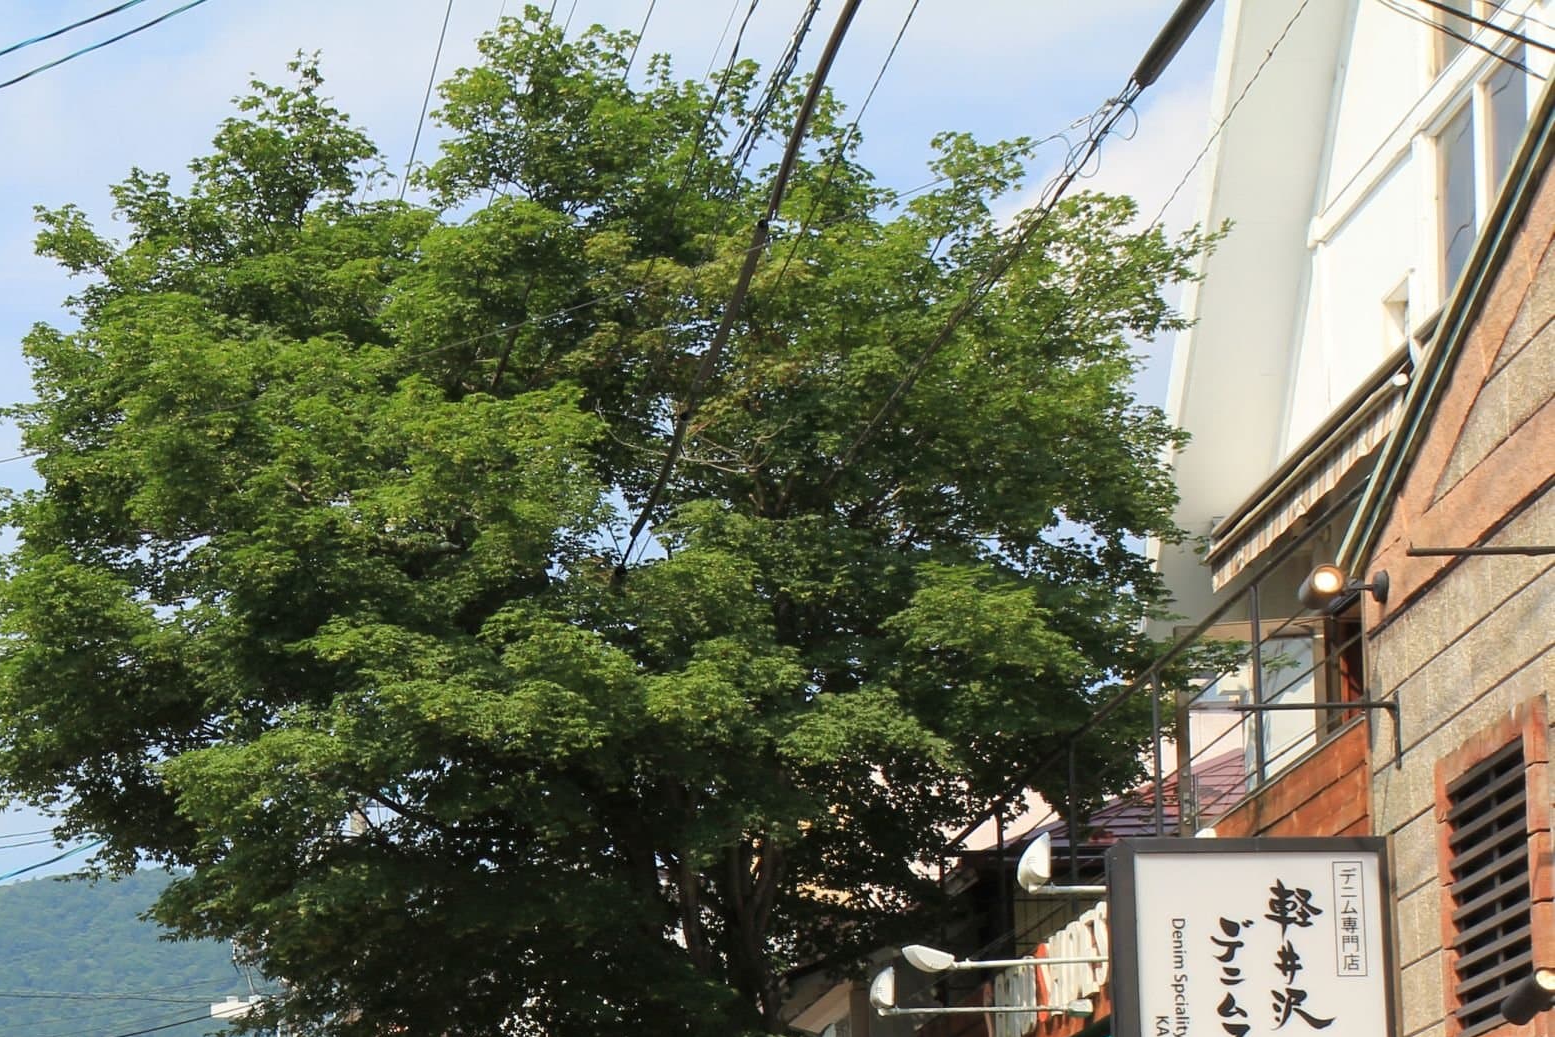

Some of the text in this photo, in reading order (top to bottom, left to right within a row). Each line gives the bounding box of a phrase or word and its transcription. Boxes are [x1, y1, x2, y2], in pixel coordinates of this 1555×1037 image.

[1171, 917, 1186, 971] Denim
[1264, 878, 1337, 1031] 軽井沢
[1339, 867, 1362, 972] デニム専門店
